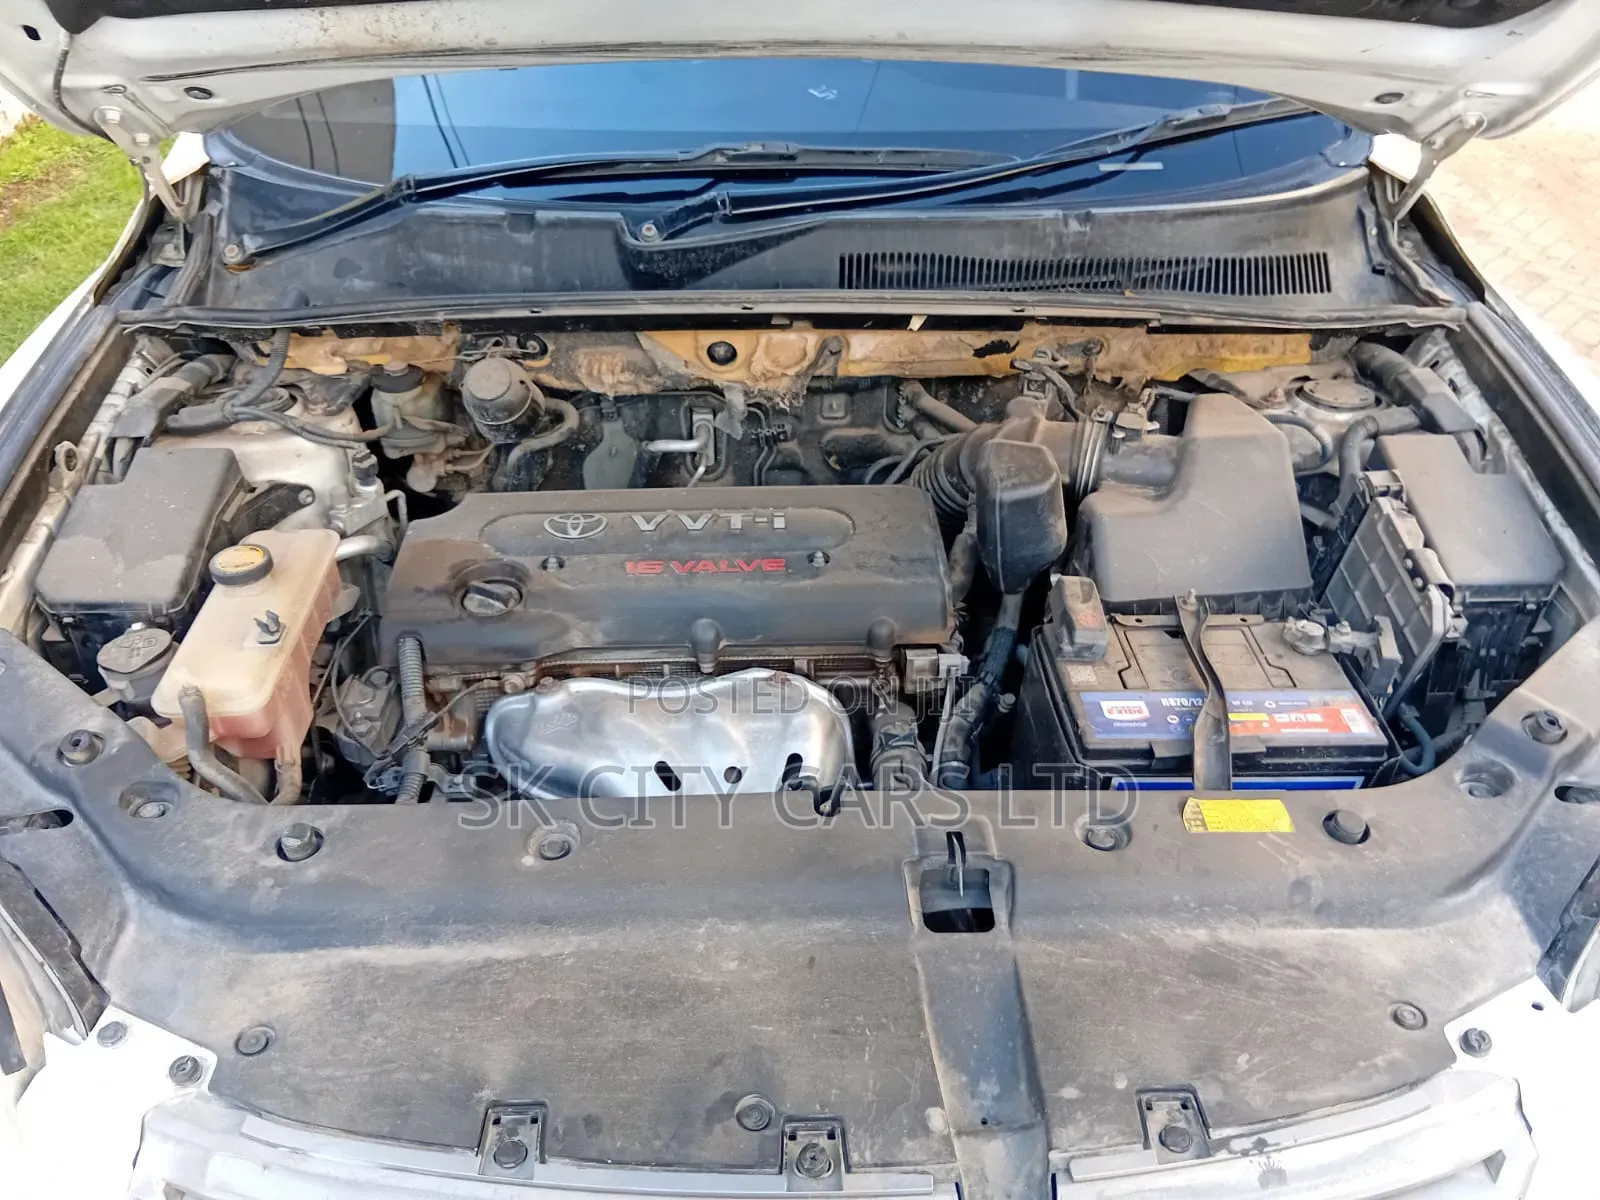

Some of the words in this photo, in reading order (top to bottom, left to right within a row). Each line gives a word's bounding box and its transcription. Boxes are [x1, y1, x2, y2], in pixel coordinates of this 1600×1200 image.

[629, 511, 786, 532] VVT-i
[625, 559, 665, 575] 16
[671, 557, 786, 574] VALVE
